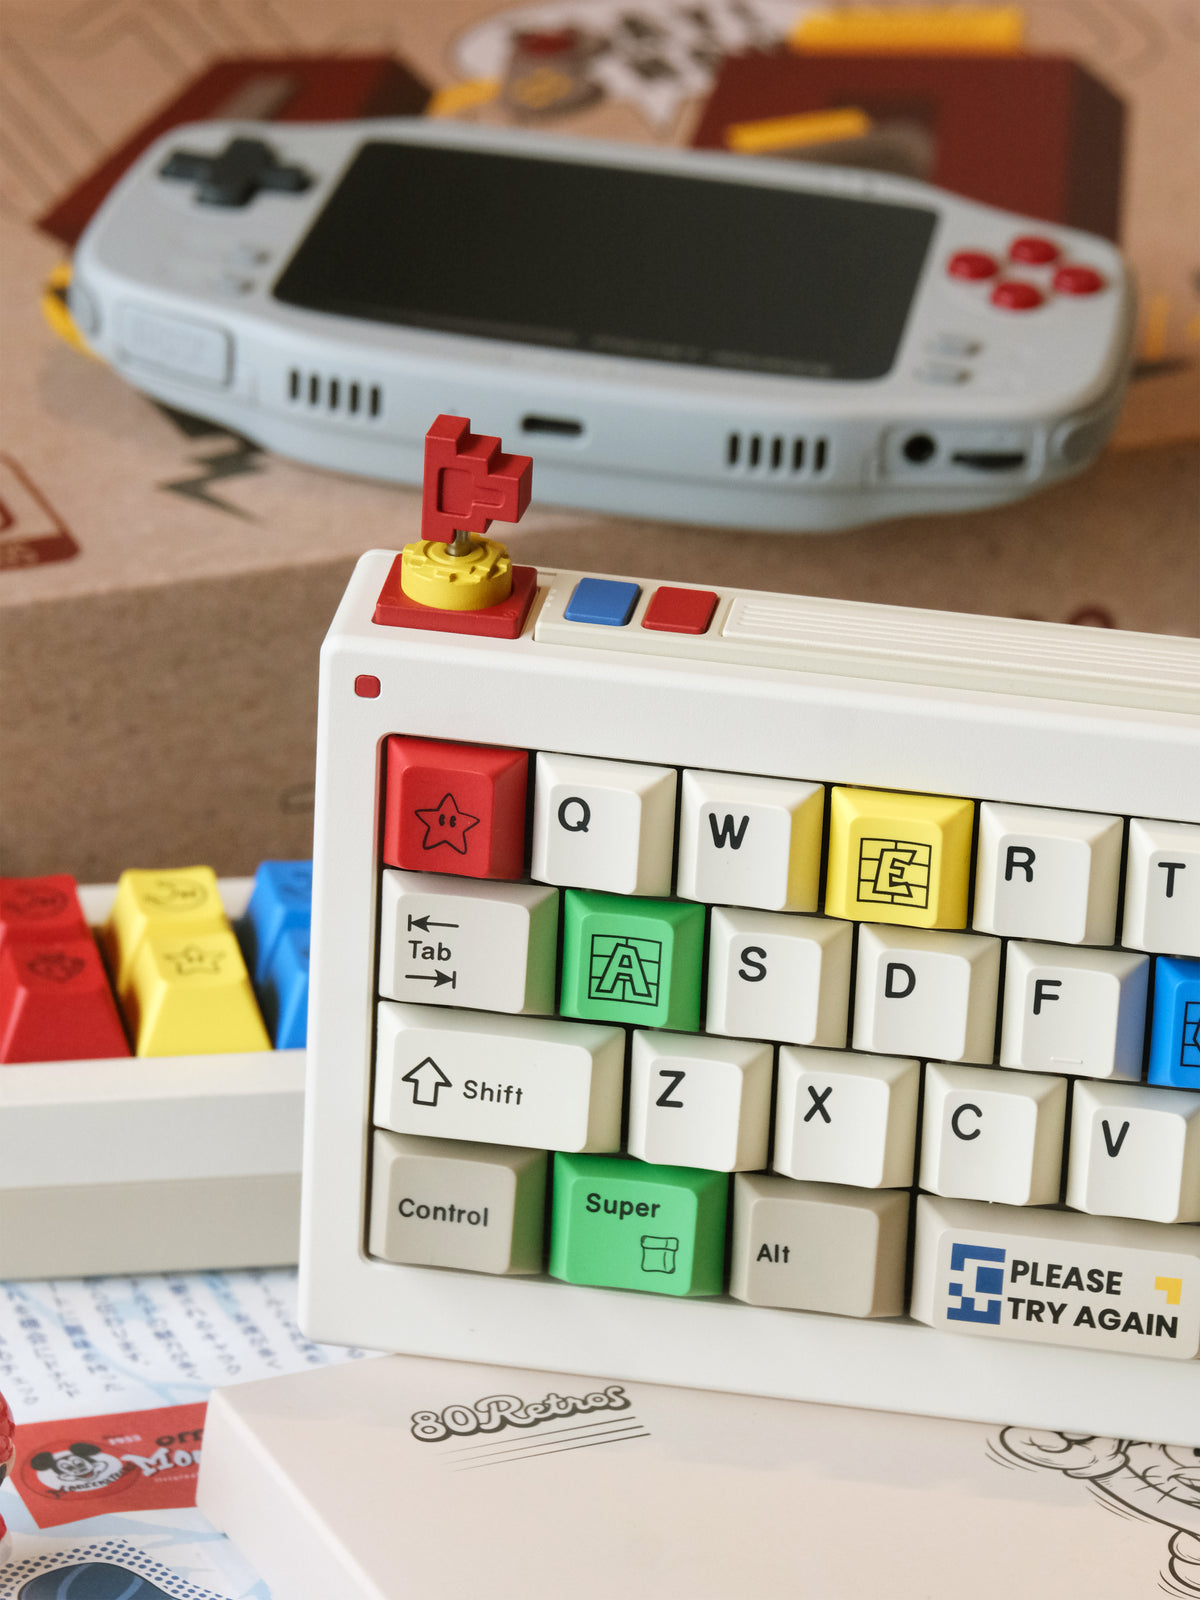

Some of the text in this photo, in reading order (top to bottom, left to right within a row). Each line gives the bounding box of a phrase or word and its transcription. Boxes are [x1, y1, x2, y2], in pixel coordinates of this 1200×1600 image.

[558, 797, 590, 832] Q
[709, 813, 749, 849] W
[872, 848, 917, 898] E
[1005, 846, 1035, 882] R
[1158, 862, 1186, 898] T
[408, 940, 451, 961] Tab
[739, 946, 766, 982] S
[595, 943, 652, 997] A
[885, 963, 915, 998] D
[1033, 980, 1062, 1015] F
[463, 1080, 522, 1105] Shift
[656, 1070, 685, 1108] Z
[804, 1086, 832, 1123] X
[952, 1104, 982, 1140] C
[1102, 1120, 1129, 1157] V
[399, 1198, 488, 1226] Control
[586, 1193, 660, 1220] Super
[757, 1244, 789, 1263] Alt
[1010, 1259, 1122, 1296] PLEASE
[1007, 1297, 1178, 1338] TRY AGAIN
[411, 1385, 631, 1442] 80Retros
